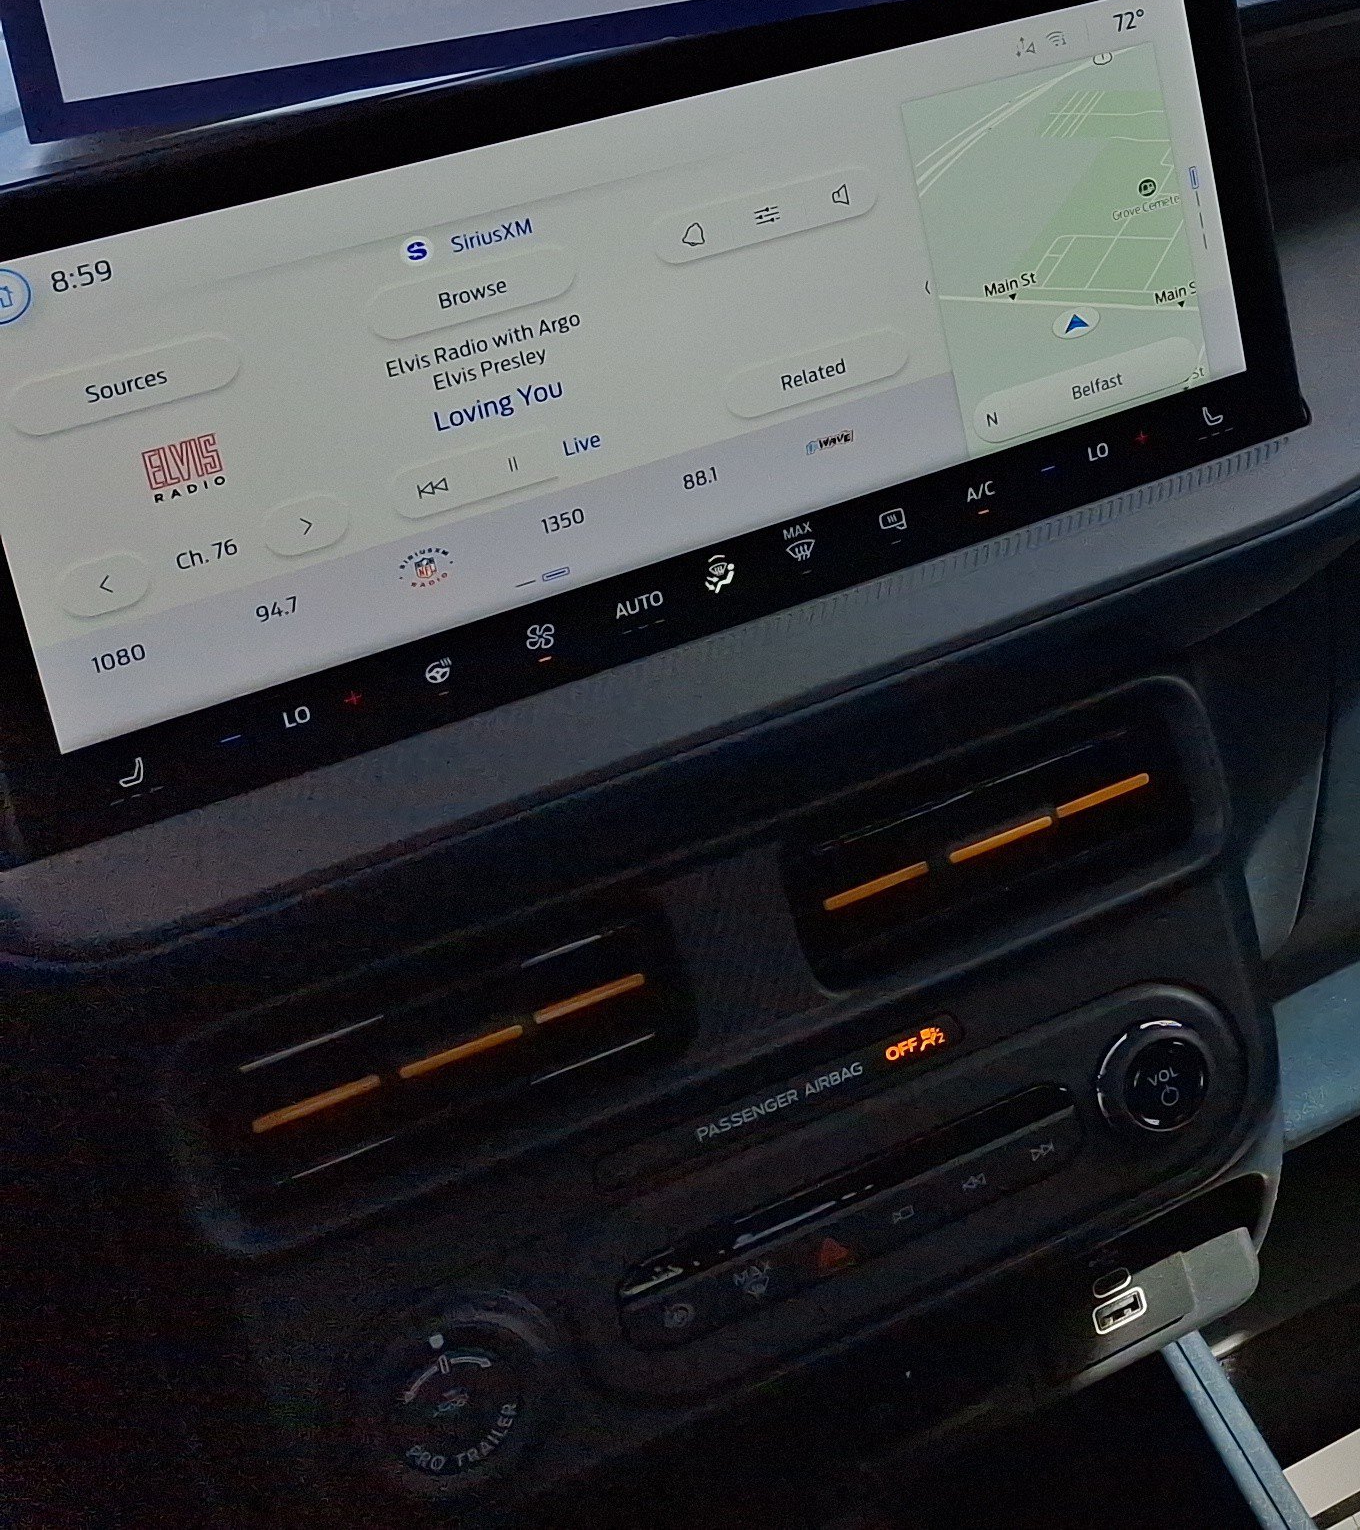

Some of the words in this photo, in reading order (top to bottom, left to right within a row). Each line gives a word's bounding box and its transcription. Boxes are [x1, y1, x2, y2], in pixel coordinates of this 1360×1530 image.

[1113, 9, 1144, 32] 72°
[1112, 205, 1141, 221] Grove
[450, 218, 533, 253] SiriusXM
[50, 259, 112, 292] 8:59
[982, 279, 1016, 299] Main
[1018, 271, 1037, 288] St
[438, 280, 507, 309] Browse
[1154, 287, 1187, 305] Main
[386, 352, 431, 378] Elvis
[433, 339, 488, 365] Radio
[492, 324, 534, 349] with
[538, 313, 581, 338] Argo
[433, 367, 477, 391] Elvis
[480, 349, 547, 378] Presley
[780, 358, 847, 391] Related
[85, 371, 168, 403] Sources
[1071, 373, 1123, 400] Belfast
[434, 395, 515, 432] Loving
[516, 381, 563, 407] You
[986, 411, 999, 427] N
[562, 432, 602, 458] Live
[1086, 441, 1110, 461] LO
[141, 432, 224, 490] ELVIS
[154, 475, 226, 504] RADIO
[682, 466, 719, 491] 88.1
[966, 480, 997, 504] A/C
[540, 507, 586, 536] 1350
[782, 521, 812, 540] MAX
[176, 550, 210, 570] Ch.
[211, 539, 238, 559] 76
[255, 595, 299, 624] 94.7
[614, 589, 666, 620] AUTO
[90, 643, 147, 673] 1080
[282, 706, 312, 730] LO
[885, 1037, 918, 1061] OFF
[1147, 1065, 1180, 1089] VOL
[697, 1089, 799, 1143] PASSENGER
[804, 1062, 864, 1097] AIRBAG
